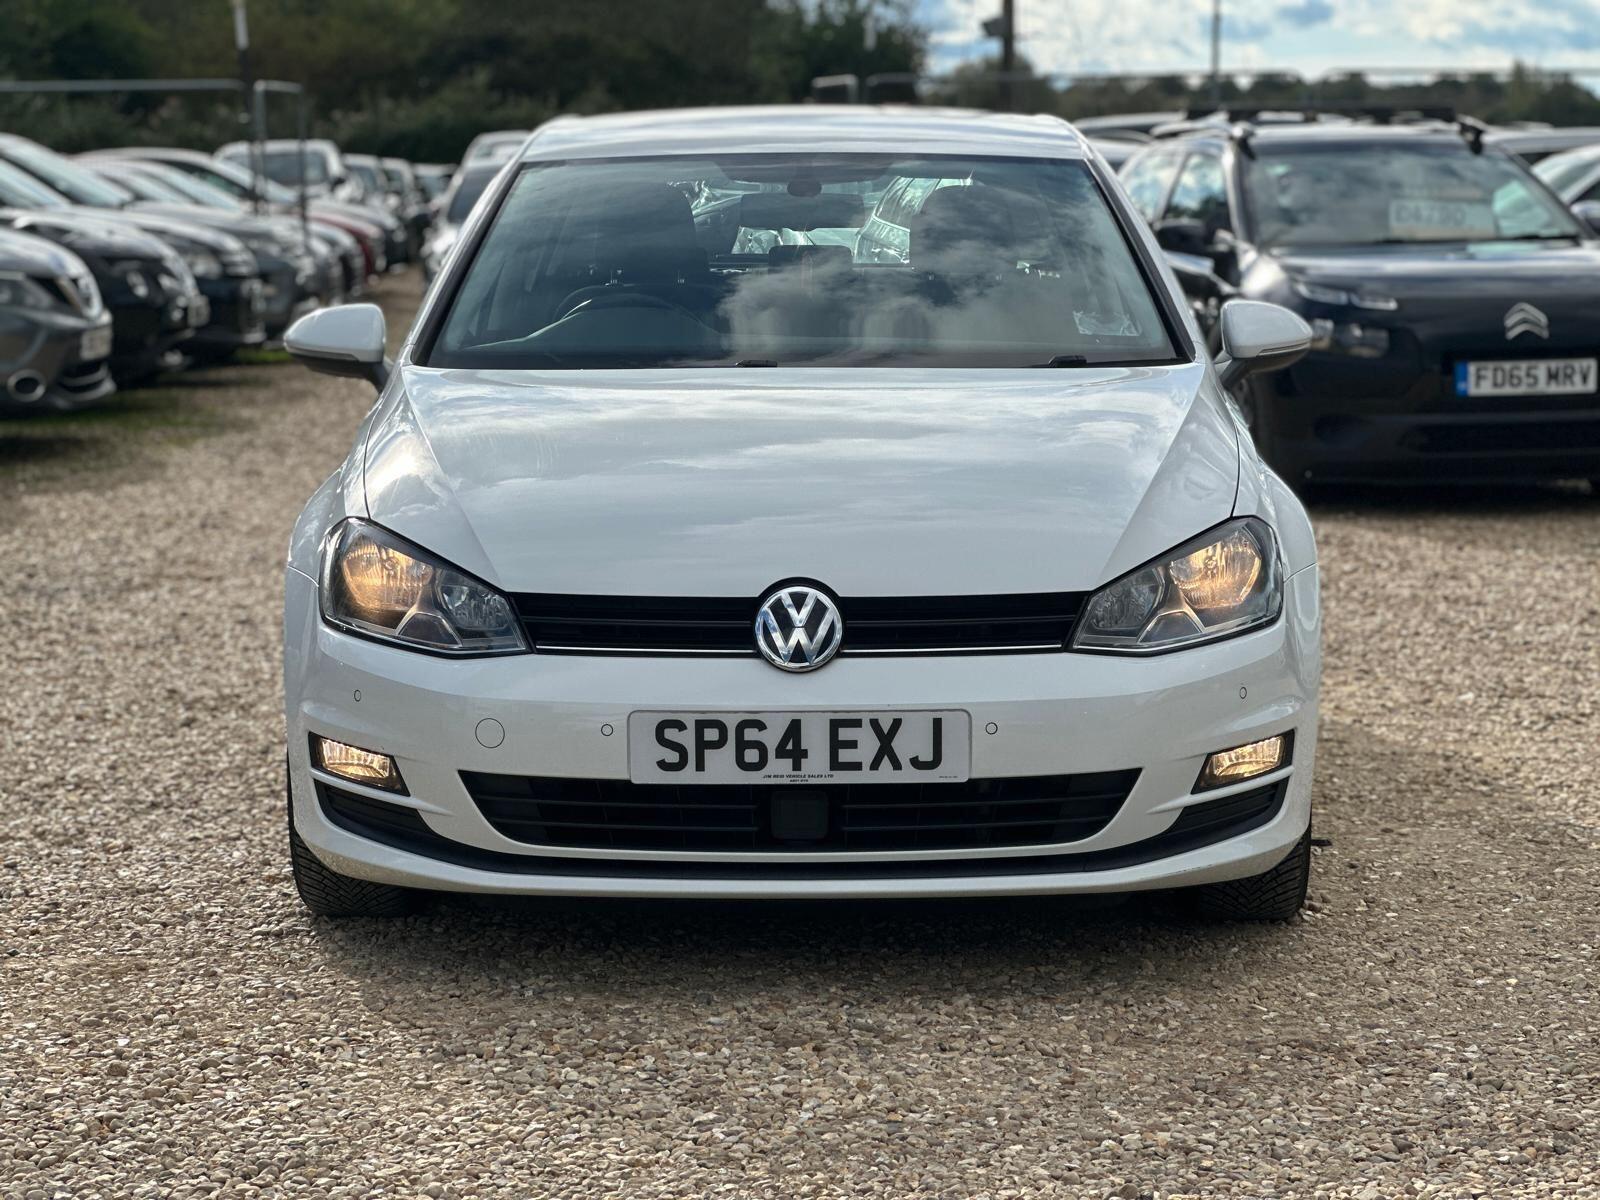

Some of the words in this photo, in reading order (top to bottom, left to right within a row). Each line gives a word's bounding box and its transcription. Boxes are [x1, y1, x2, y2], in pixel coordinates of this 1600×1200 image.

[1474, 364, 1538, 389] FD65
[1546, 363, 1592, 387] MRV
[757, 588, 840, 669] VW
[655, 718, 809, 772] SP64
[829, 717, 943, 772] EXJ
